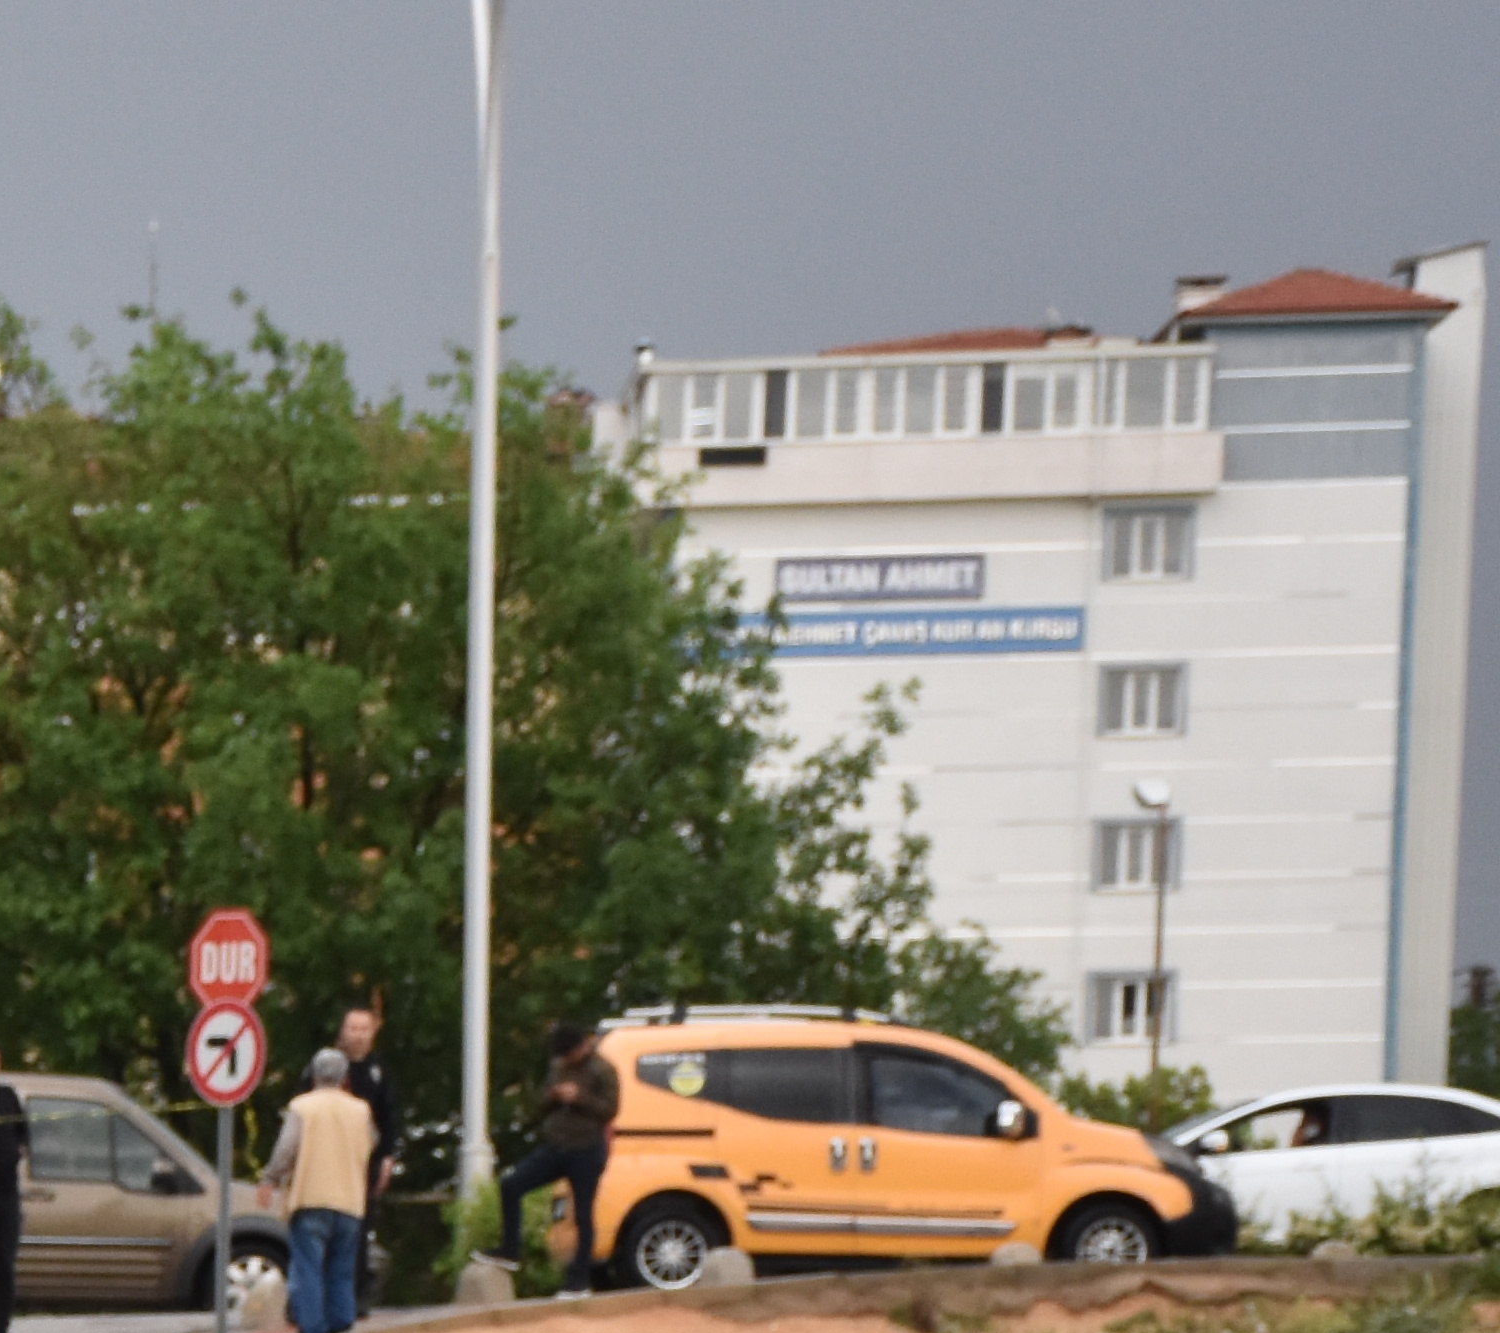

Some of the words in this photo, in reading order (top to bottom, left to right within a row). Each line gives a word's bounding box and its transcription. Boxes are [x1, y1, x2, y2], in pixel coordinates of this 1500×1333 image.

[778, 562, 880, 595] SULTAN
[883, 560, 978, 592] AHMET
[200, 939, 257, 985] DUR
